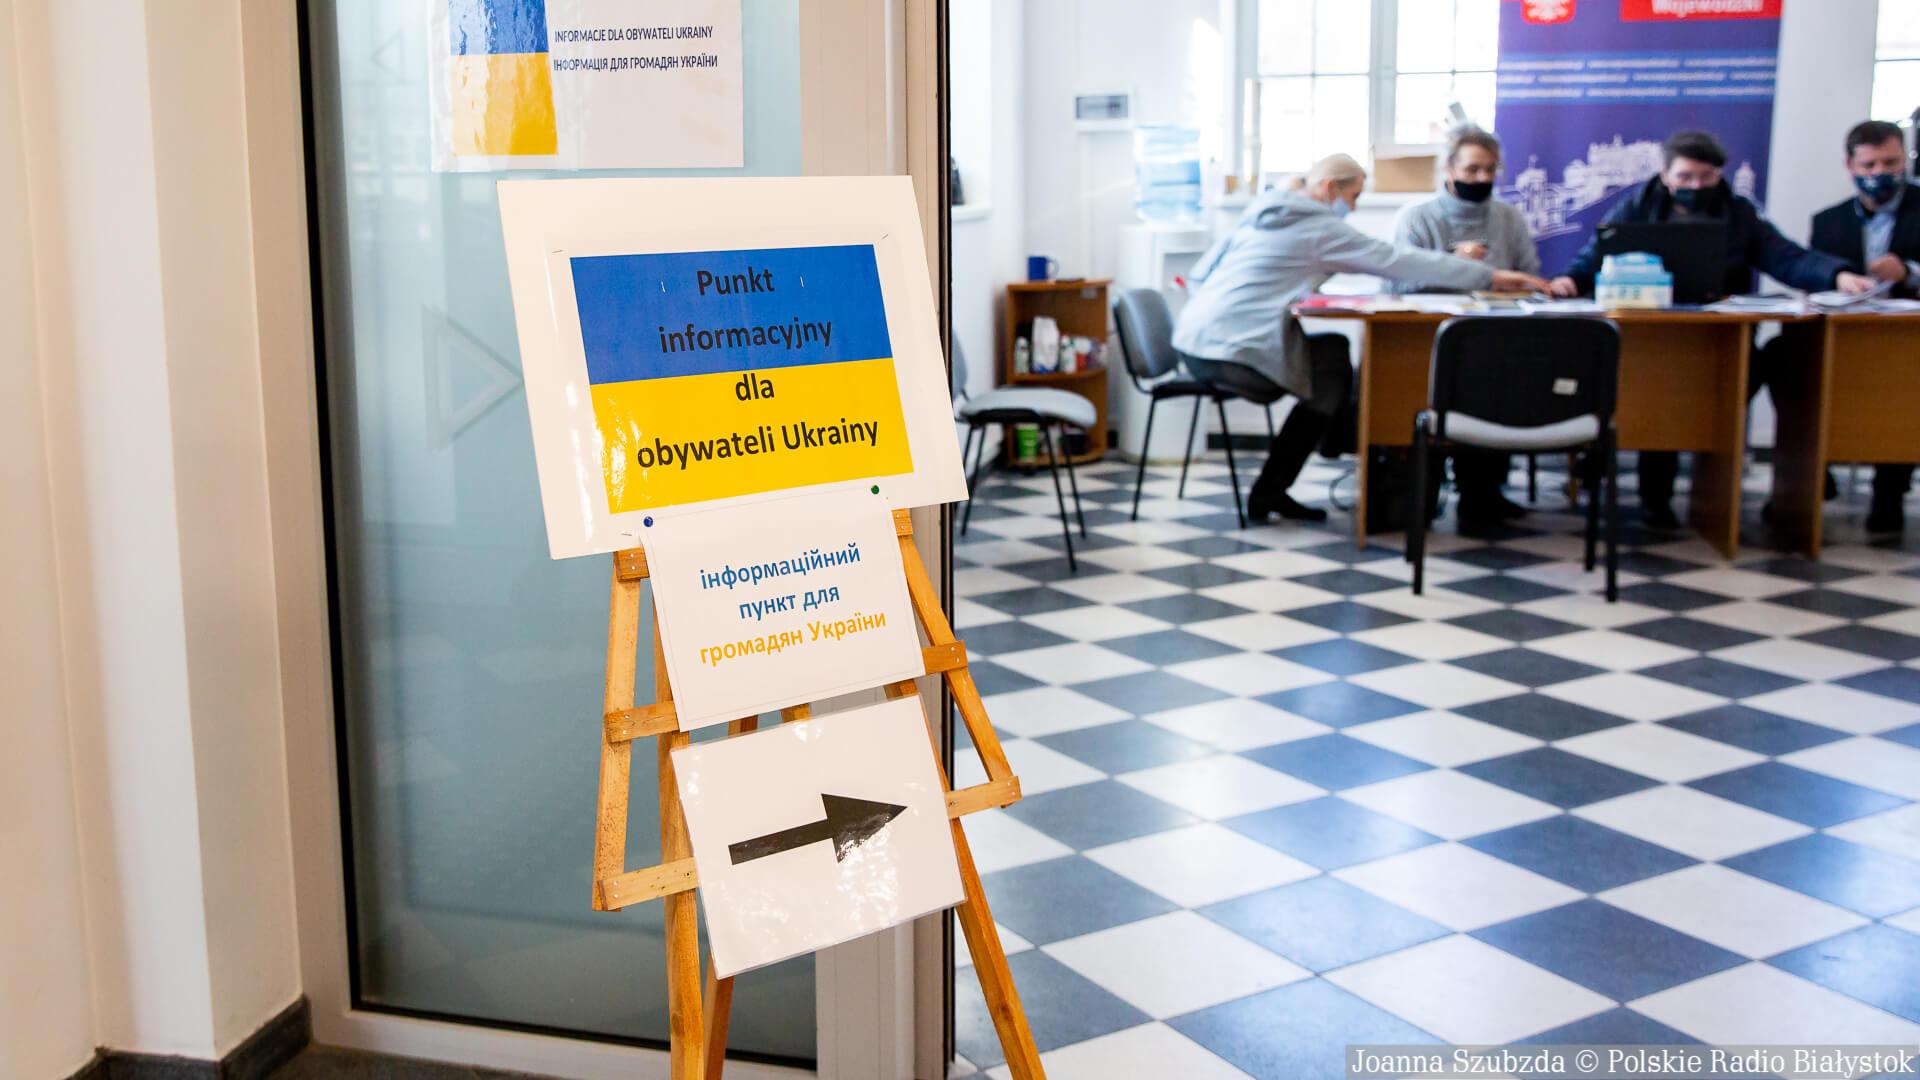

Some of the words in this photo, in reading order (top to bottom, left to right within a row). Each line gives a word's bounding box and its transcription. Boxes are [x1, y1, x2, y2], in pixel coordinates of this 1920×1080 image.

[554, 29, 606, 43] INFORMACJE
[608, 28, 624, 42] DLA
[626, 27, 674, 41] OBYWATELI
[676, 26, 713, 39] UKRAINY
[553, 57, 608, 72] ІНФОРМАЦІЯ
[610, 57, 628, 72] ДЛЯ
[630, 56, 679, 71] ГРОМАДЯН
[681, 52, 718, 68] УКРАЇНИ
[696, 266, 775, 296] Punkt
[659, 317, 832, 353] informacyjny
[735, 373, 775, 401] dla
[637, 426, 775, 470] obywateli
[782, 418, 878, 450] Ukrainy
[700, 542, 861, 590] інформаційний
[739, 594, 796, 621] пункт
[803, 586, 840, 611] для
[700, 628, 803, 667] громадян
[807, 612, 887, 641] України
